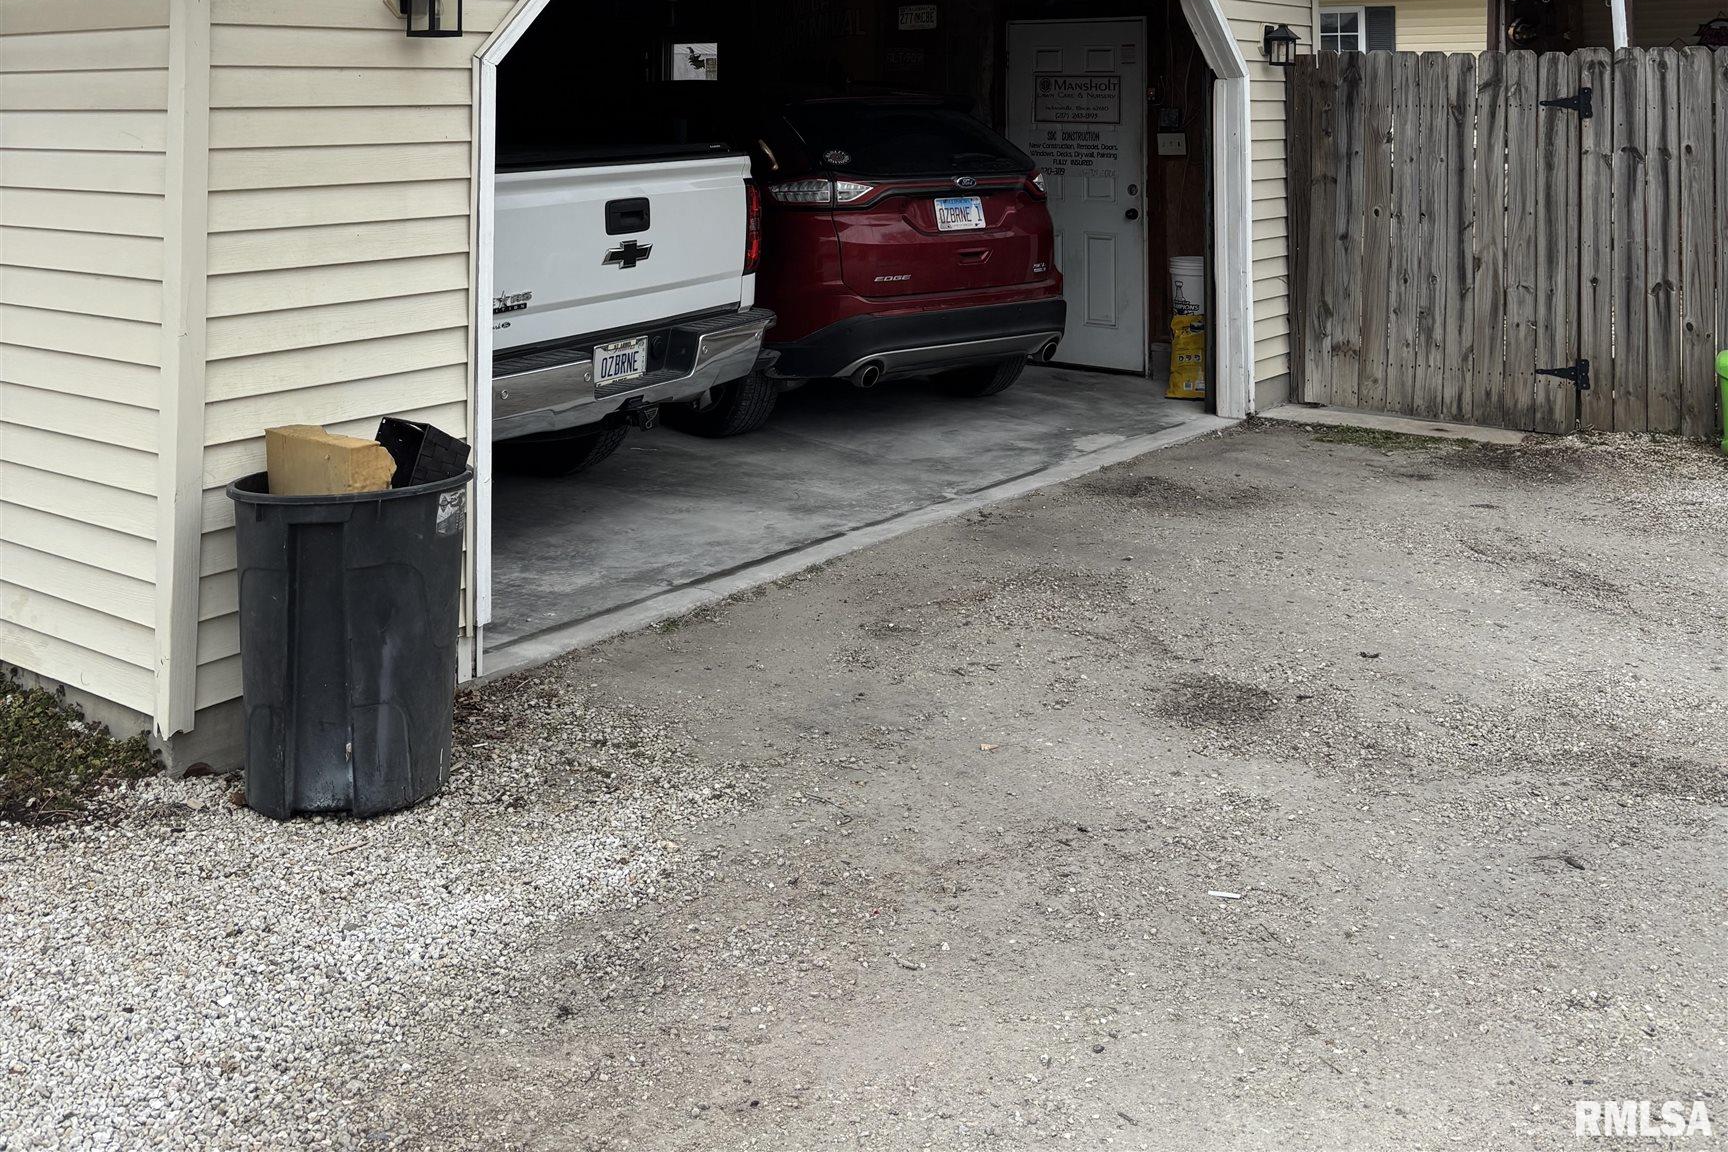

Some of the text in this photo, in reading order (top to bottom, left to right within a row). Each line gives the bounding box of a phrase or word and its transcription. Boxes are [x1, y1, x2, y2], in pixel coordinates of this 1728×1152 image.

[1061, 131, 1100, 142] CONSTRUCTION
[1097, 152, 1118, 161] Painting
[975, 206, 982, 222] 1
[874, 274, 912, 282] EDGE
[601, 351, 639, 378] OZBRNE
